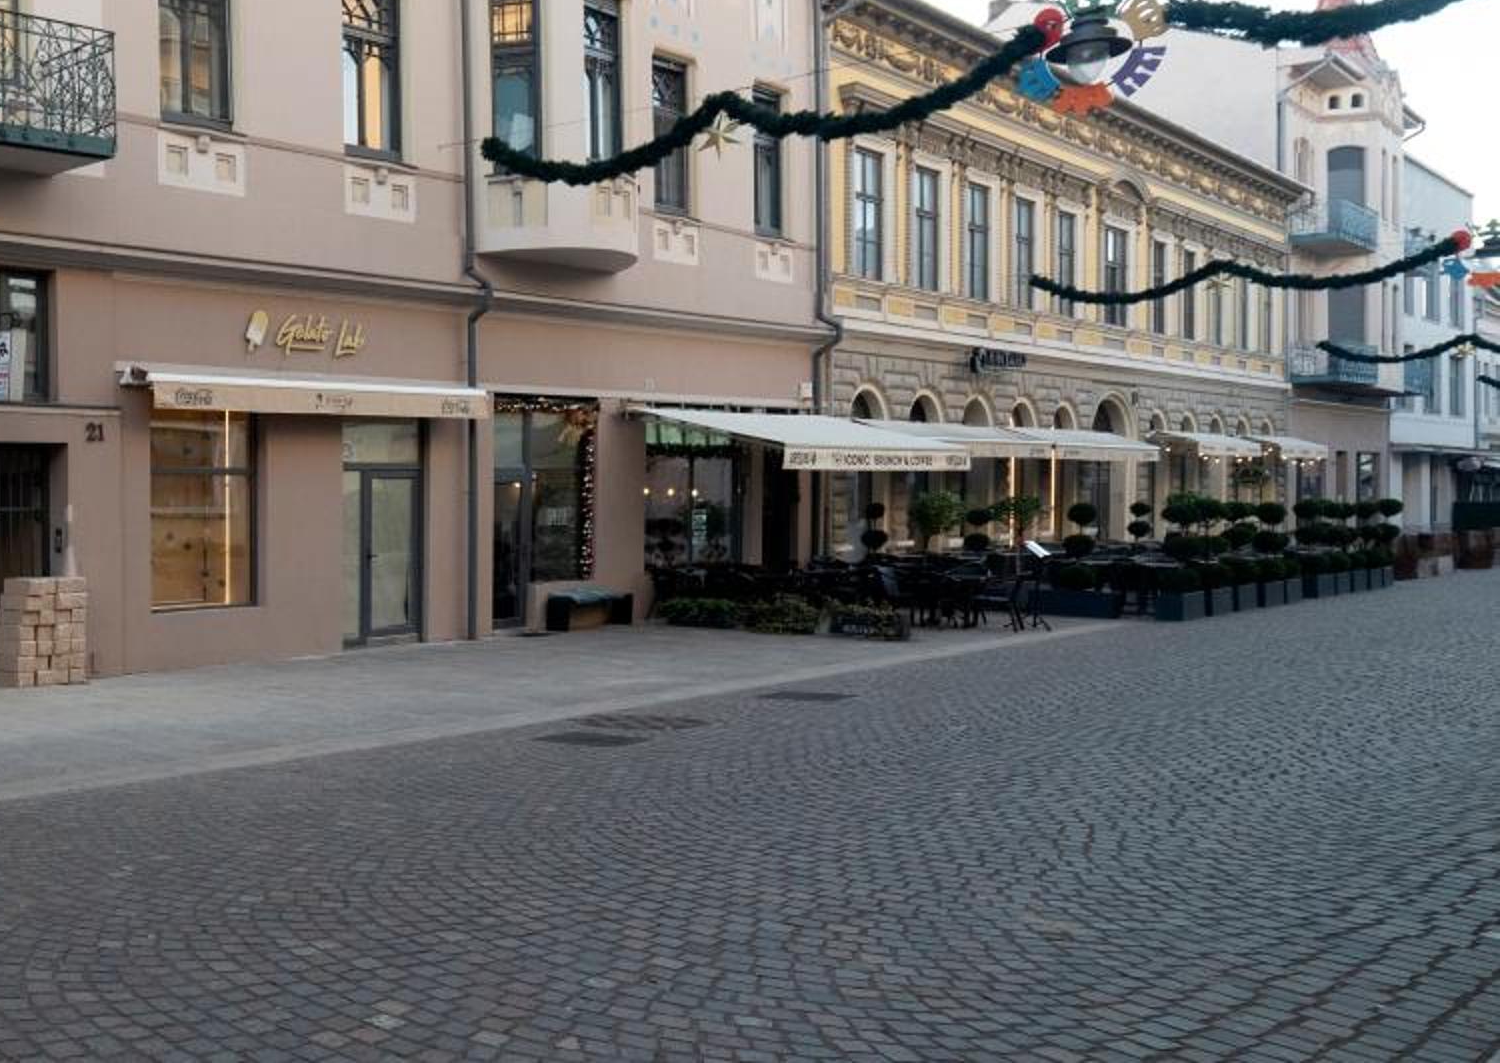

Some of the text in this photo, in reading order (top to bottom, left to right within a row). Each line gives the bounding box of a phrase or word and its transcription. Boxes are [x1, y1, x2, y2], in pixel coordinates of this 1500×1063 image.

[275, 314, 366, 356] Gelato Lab
[85, 422, 105, 442] 21
